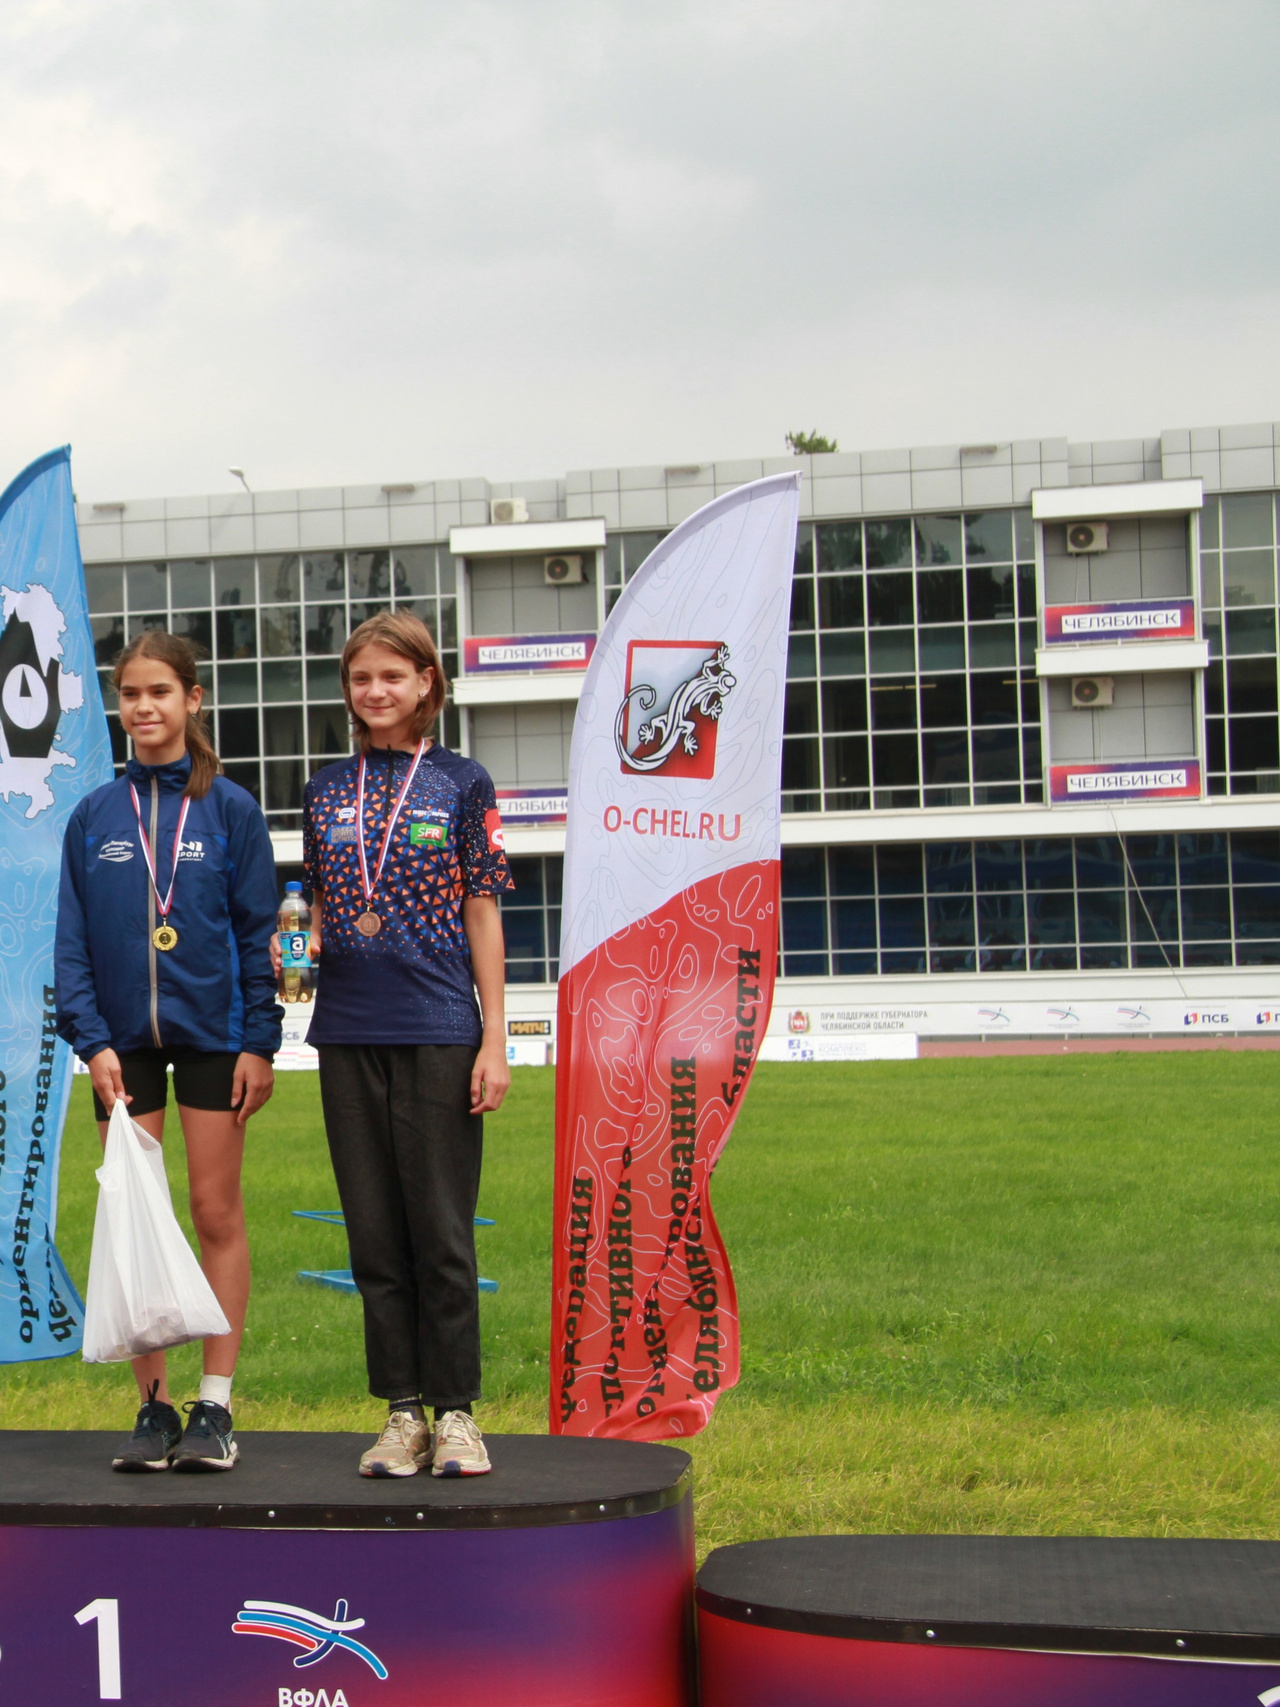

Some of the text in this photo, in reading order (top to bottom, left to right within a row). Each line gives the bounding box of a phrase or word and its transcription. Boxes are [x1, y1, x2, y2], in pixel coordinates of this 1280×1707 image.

[1064, 612, 1177, 629] ЧЕЛЯБИНСК
[481, 646, 582, 661] ЧЕЛЯБИНСК
[1070, 772, 1183, 789] ЧЕЛЯБИНСК
[603, 805, 741, 842] O-CHEL.RU
[418, 827, 441, 839] SFR
[178, 851, 206, 859] PORT
[820, 1010, 928, 1020] ПРИ ПОДДЕРЖКЕ ГУБЕРНАТОРА
[1202, 1014, 1229, 1023] ПСБ
[873, 1021, 904, 1029] ОБЛАСТИ
[13, 984, 57, 1344] ориентирования
[74, 1598, 121, 1700] 1
[278, 1687, 350, 1707] ВФЛА
